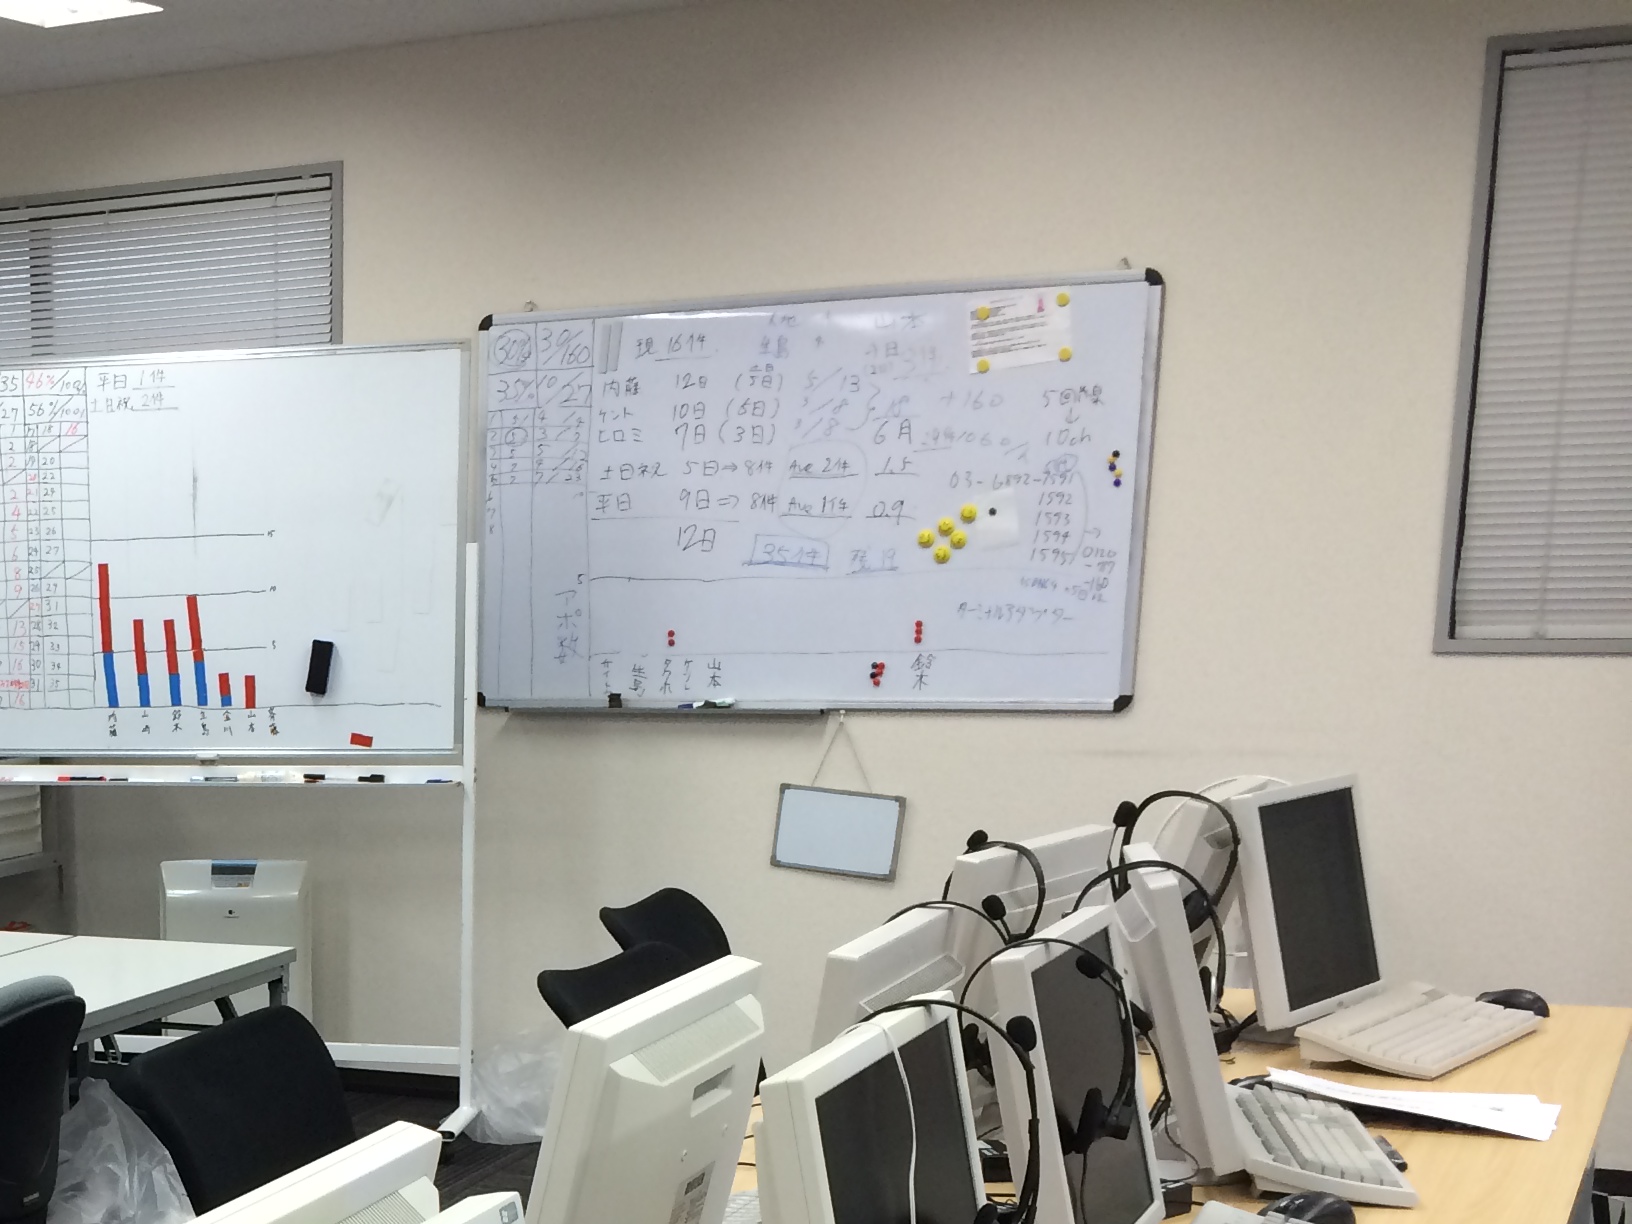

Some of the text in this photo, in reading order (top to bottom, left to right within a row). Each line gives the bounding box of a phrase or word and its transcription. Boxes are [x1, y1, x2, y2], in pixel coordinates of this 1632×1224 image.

[98, 373, 128, 391] 平日
[598, 427, 644, 443] ヒロミ
